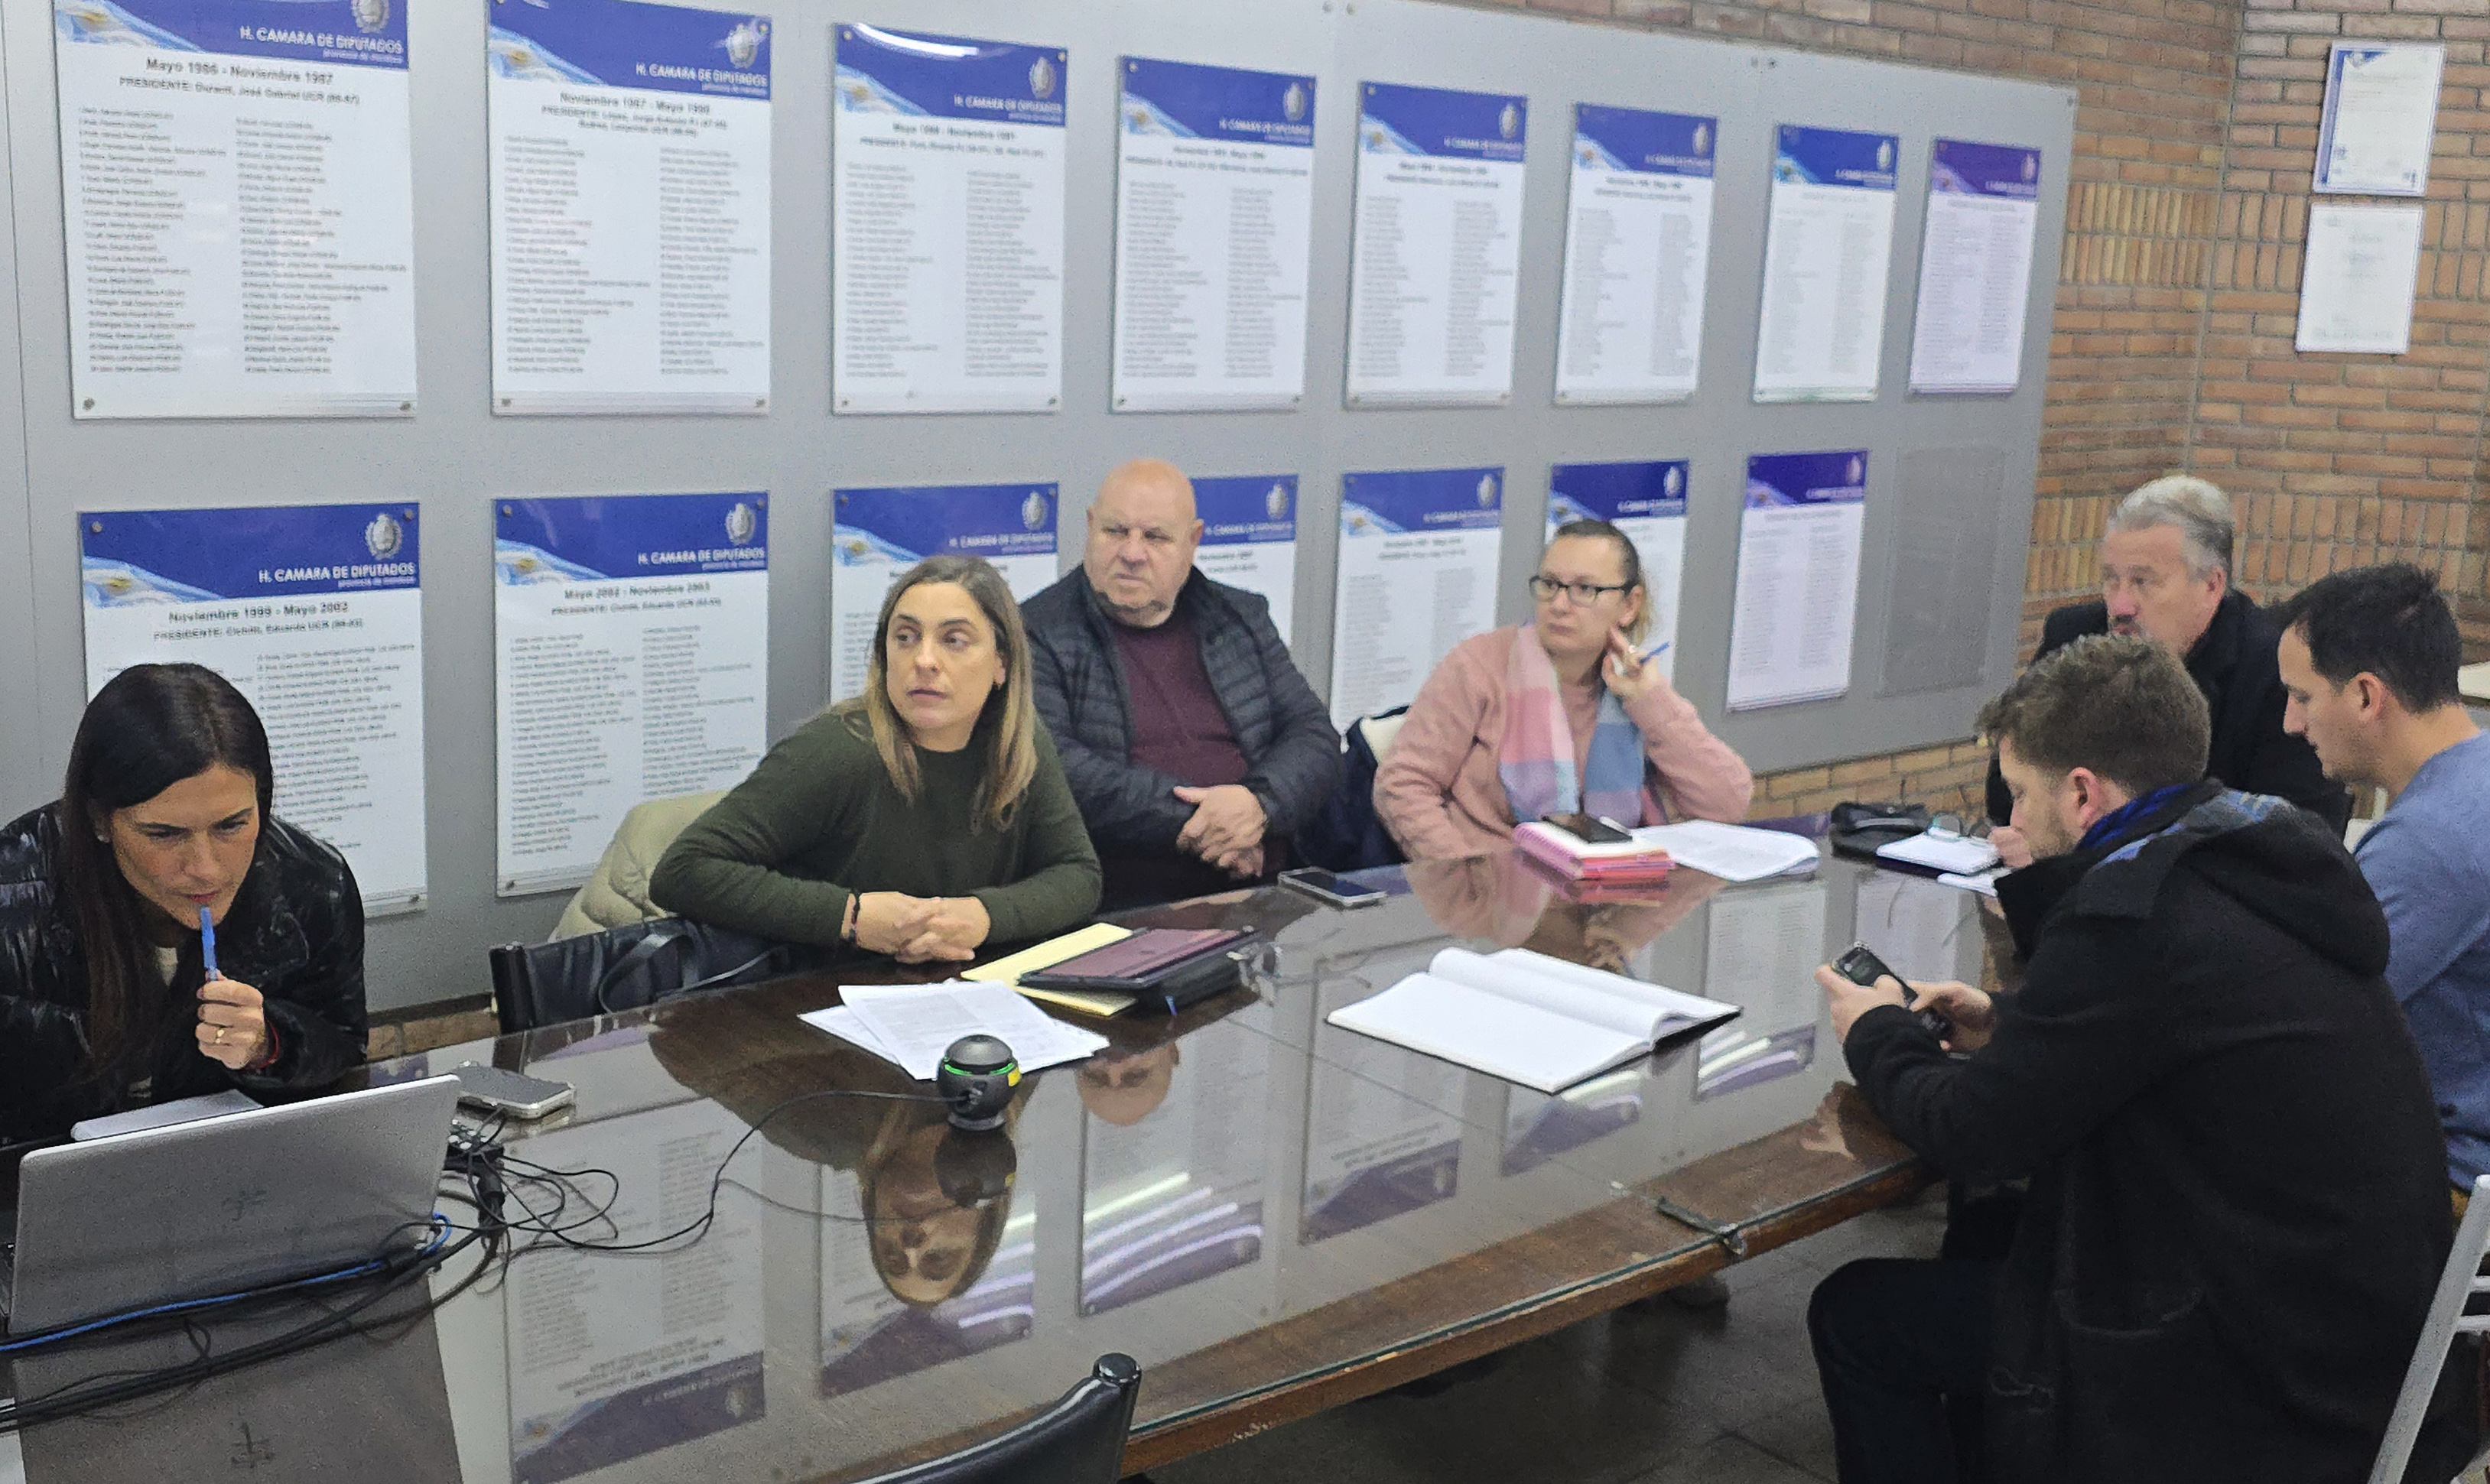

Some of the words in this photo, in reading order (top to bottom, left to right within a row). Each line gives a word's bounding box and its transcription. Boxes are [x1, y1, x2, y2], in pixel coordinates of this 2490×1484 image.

[239, 25, 253, 40] H.
[256, 28, 316, 46] CAMARA
[317, 33, 334, 47] DE
[336, 34, 404, 54] DIPUTADOS
[146, 57, 184, 74] Mayo
[230, 66, 301, 82] Noviembre
[258, 569, 272, 583] H.
[275, 567, 330, 583] CAMARA
[332, 565, 348, 579] DE
[351, 562, 416, 578] DIPUTADOS
[168, 609, 239, 623] Noviembre
[283, 603, 316, 618] Mayo
